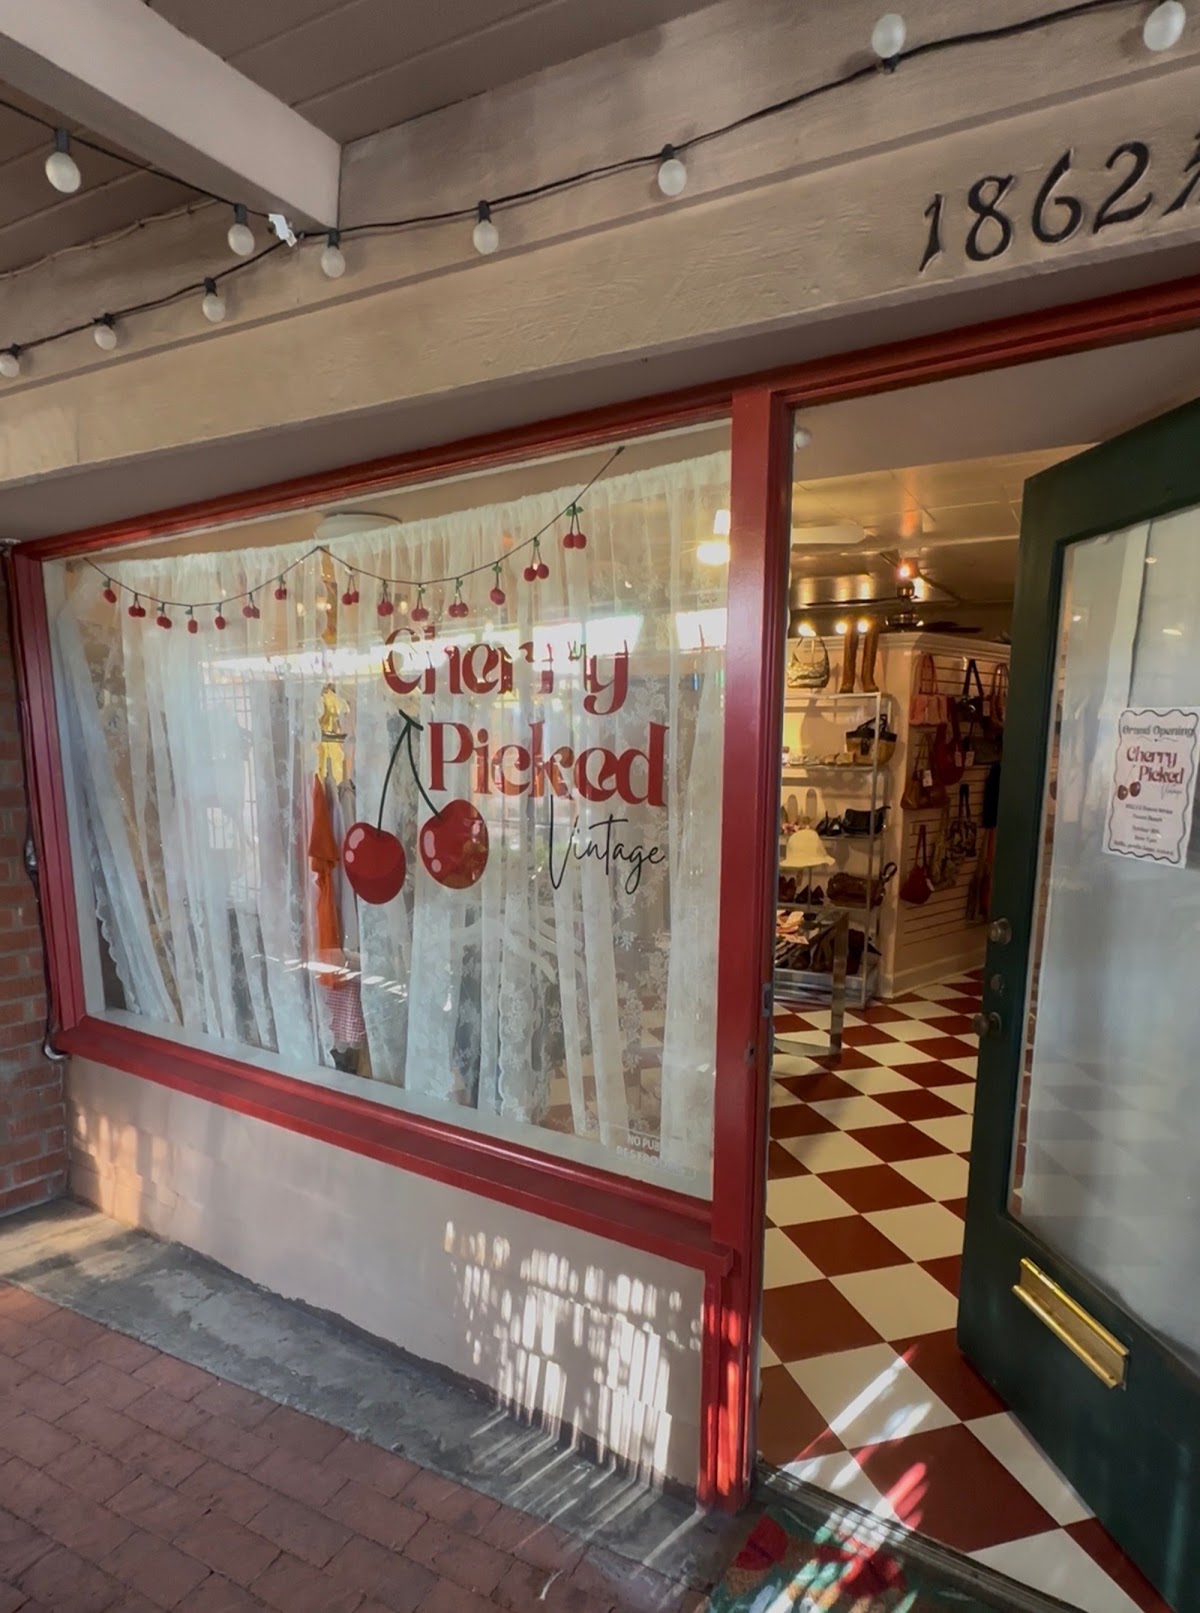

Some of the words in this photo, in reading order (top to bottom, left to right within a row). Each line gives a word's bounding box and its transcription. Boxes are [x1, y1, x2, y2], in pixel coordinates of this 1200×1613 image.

[384, 622, 629, 715] Cherry
[1153, 725, 1194, 738] Opening
[427, 720, 669, 807] Picked
[1127, 746, 1178, 768] Cherry
[1139, 766, 1185, 784] Picked
[549, 794, 666, 895] Vintage
[627, 1135, 641, 1147] NO
